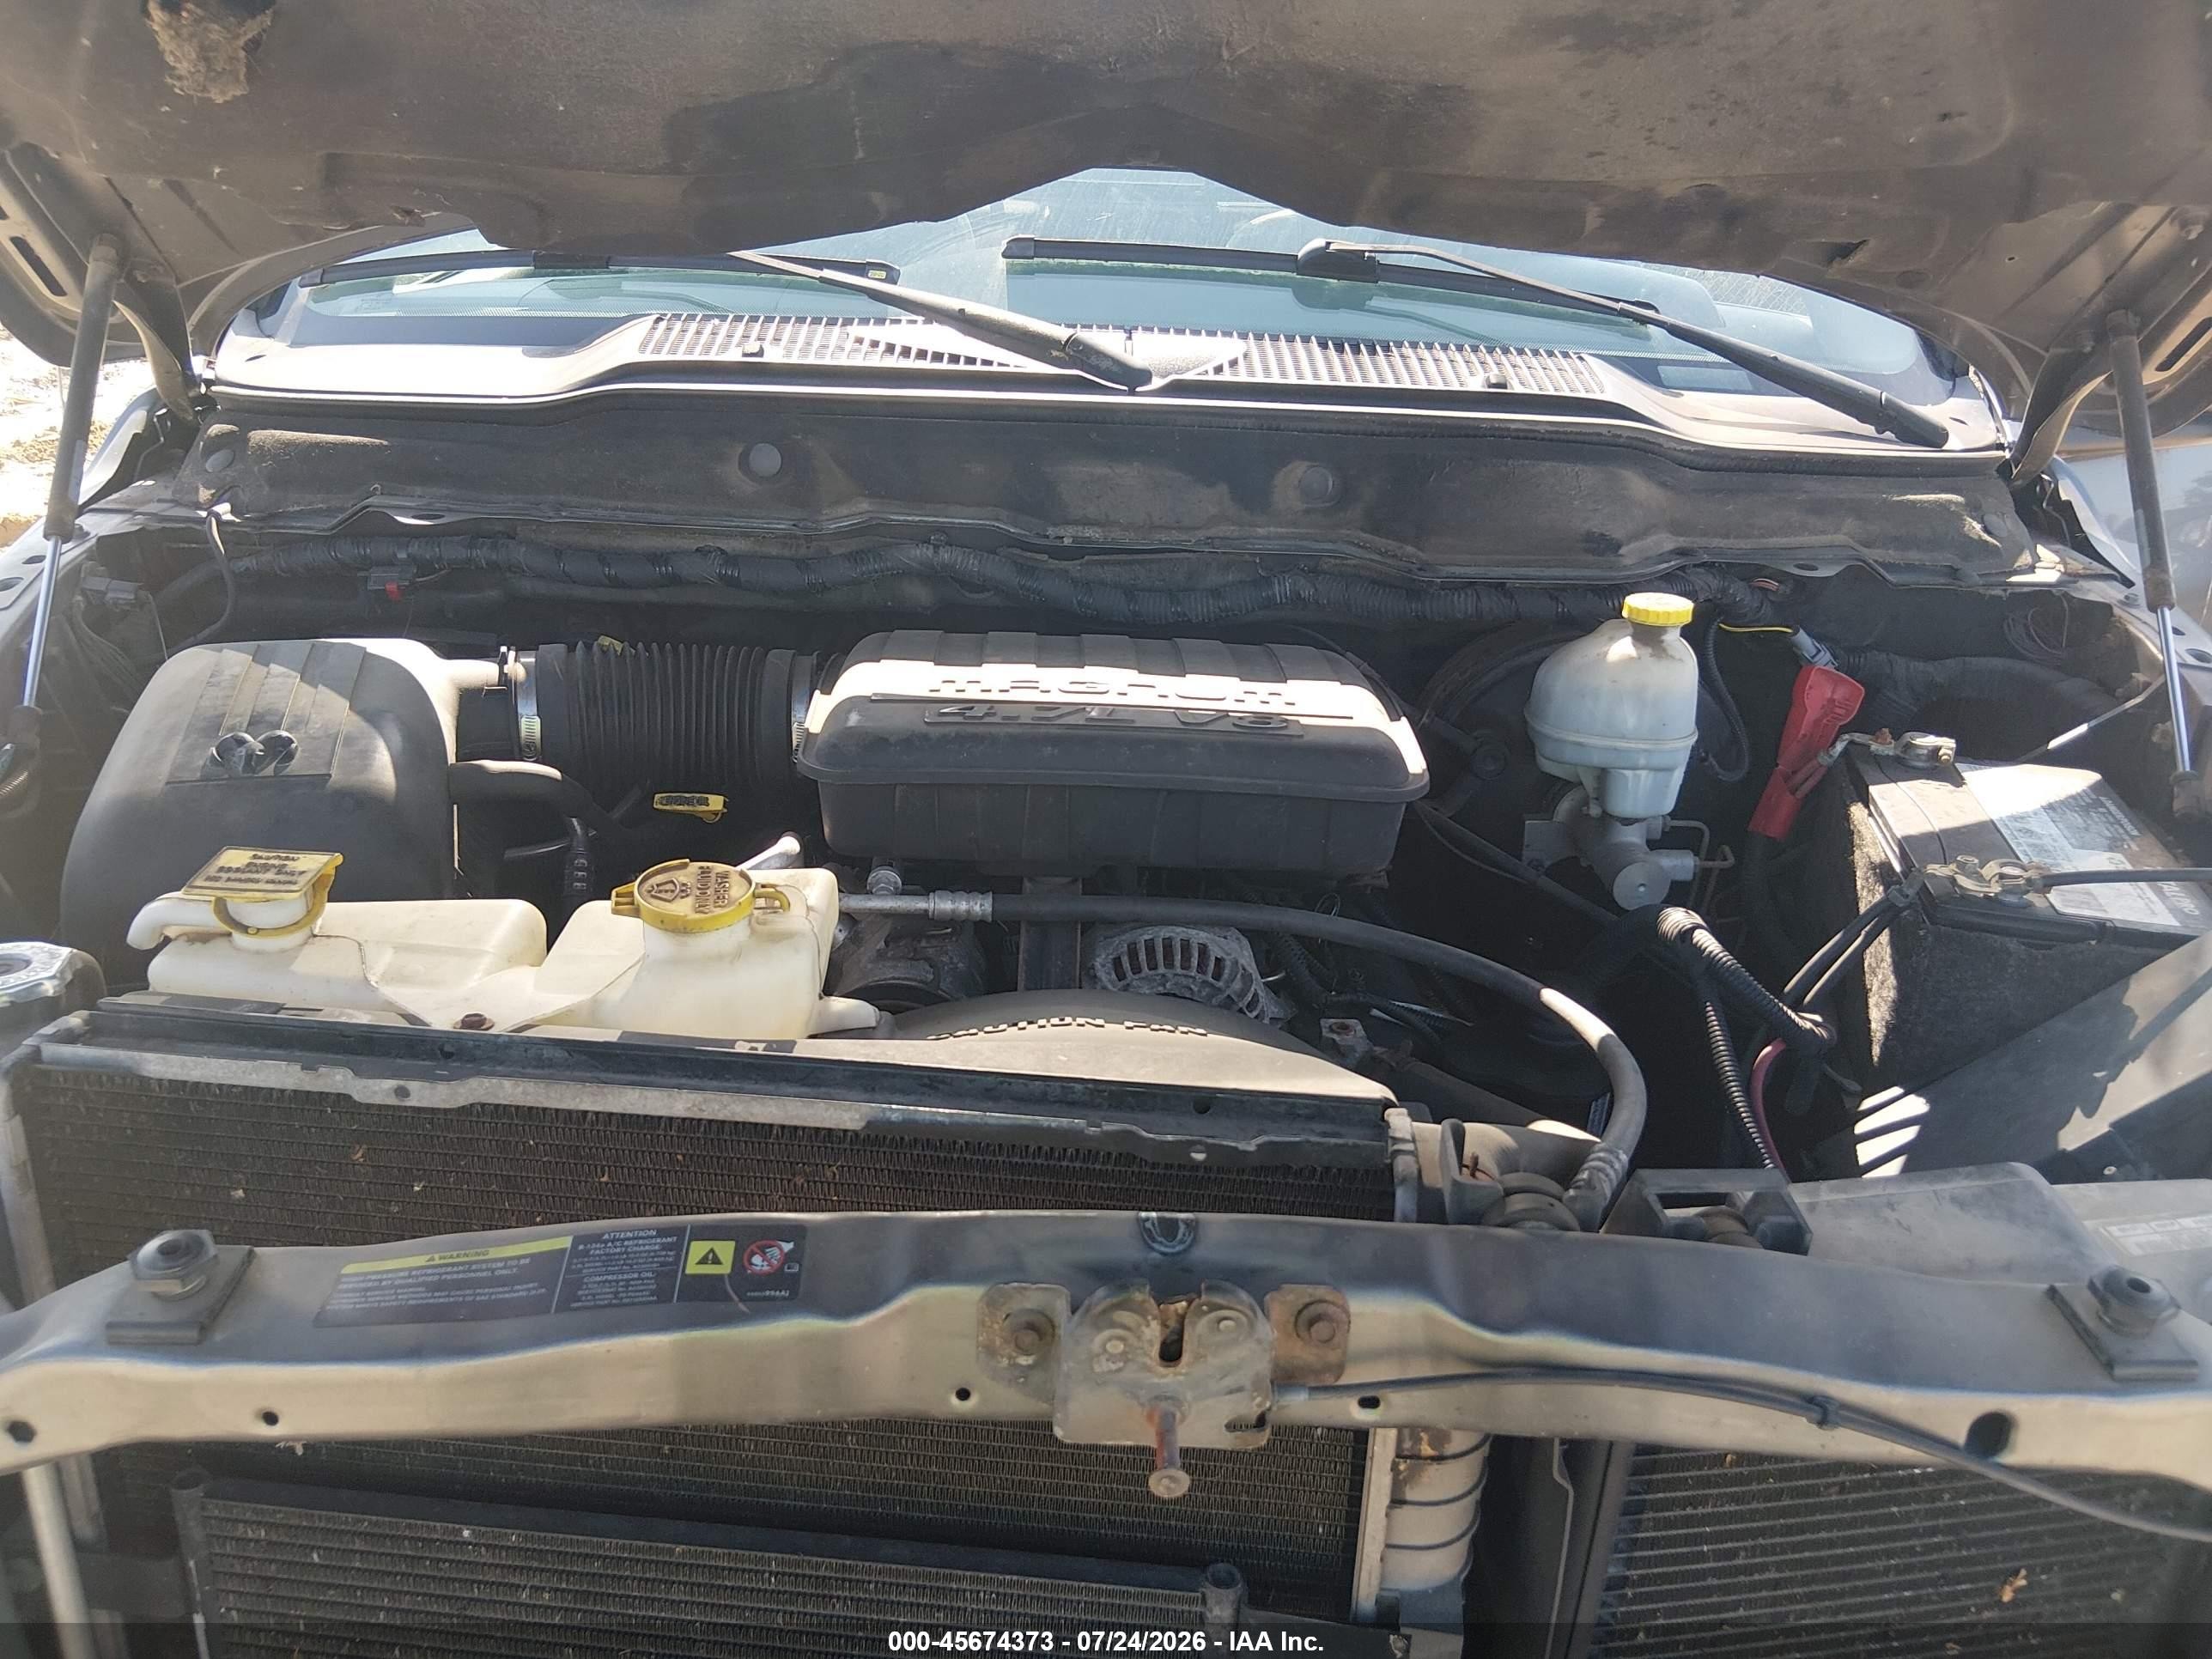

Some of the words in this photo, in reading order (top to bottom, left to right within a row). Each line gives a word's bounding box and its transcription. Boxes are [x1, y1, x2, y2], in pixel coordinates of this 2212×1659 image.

[696, 866, 714, 890] FLUID
[714, 870, 730, 908] WASHER
[695, 890, 712, 915] ONLY
[602, 1229, 657, 1239] ATTENTION
[438, 1250, 490, 1261] WARNING
[583, 1273, 639, 1282] COMPRESSOR
